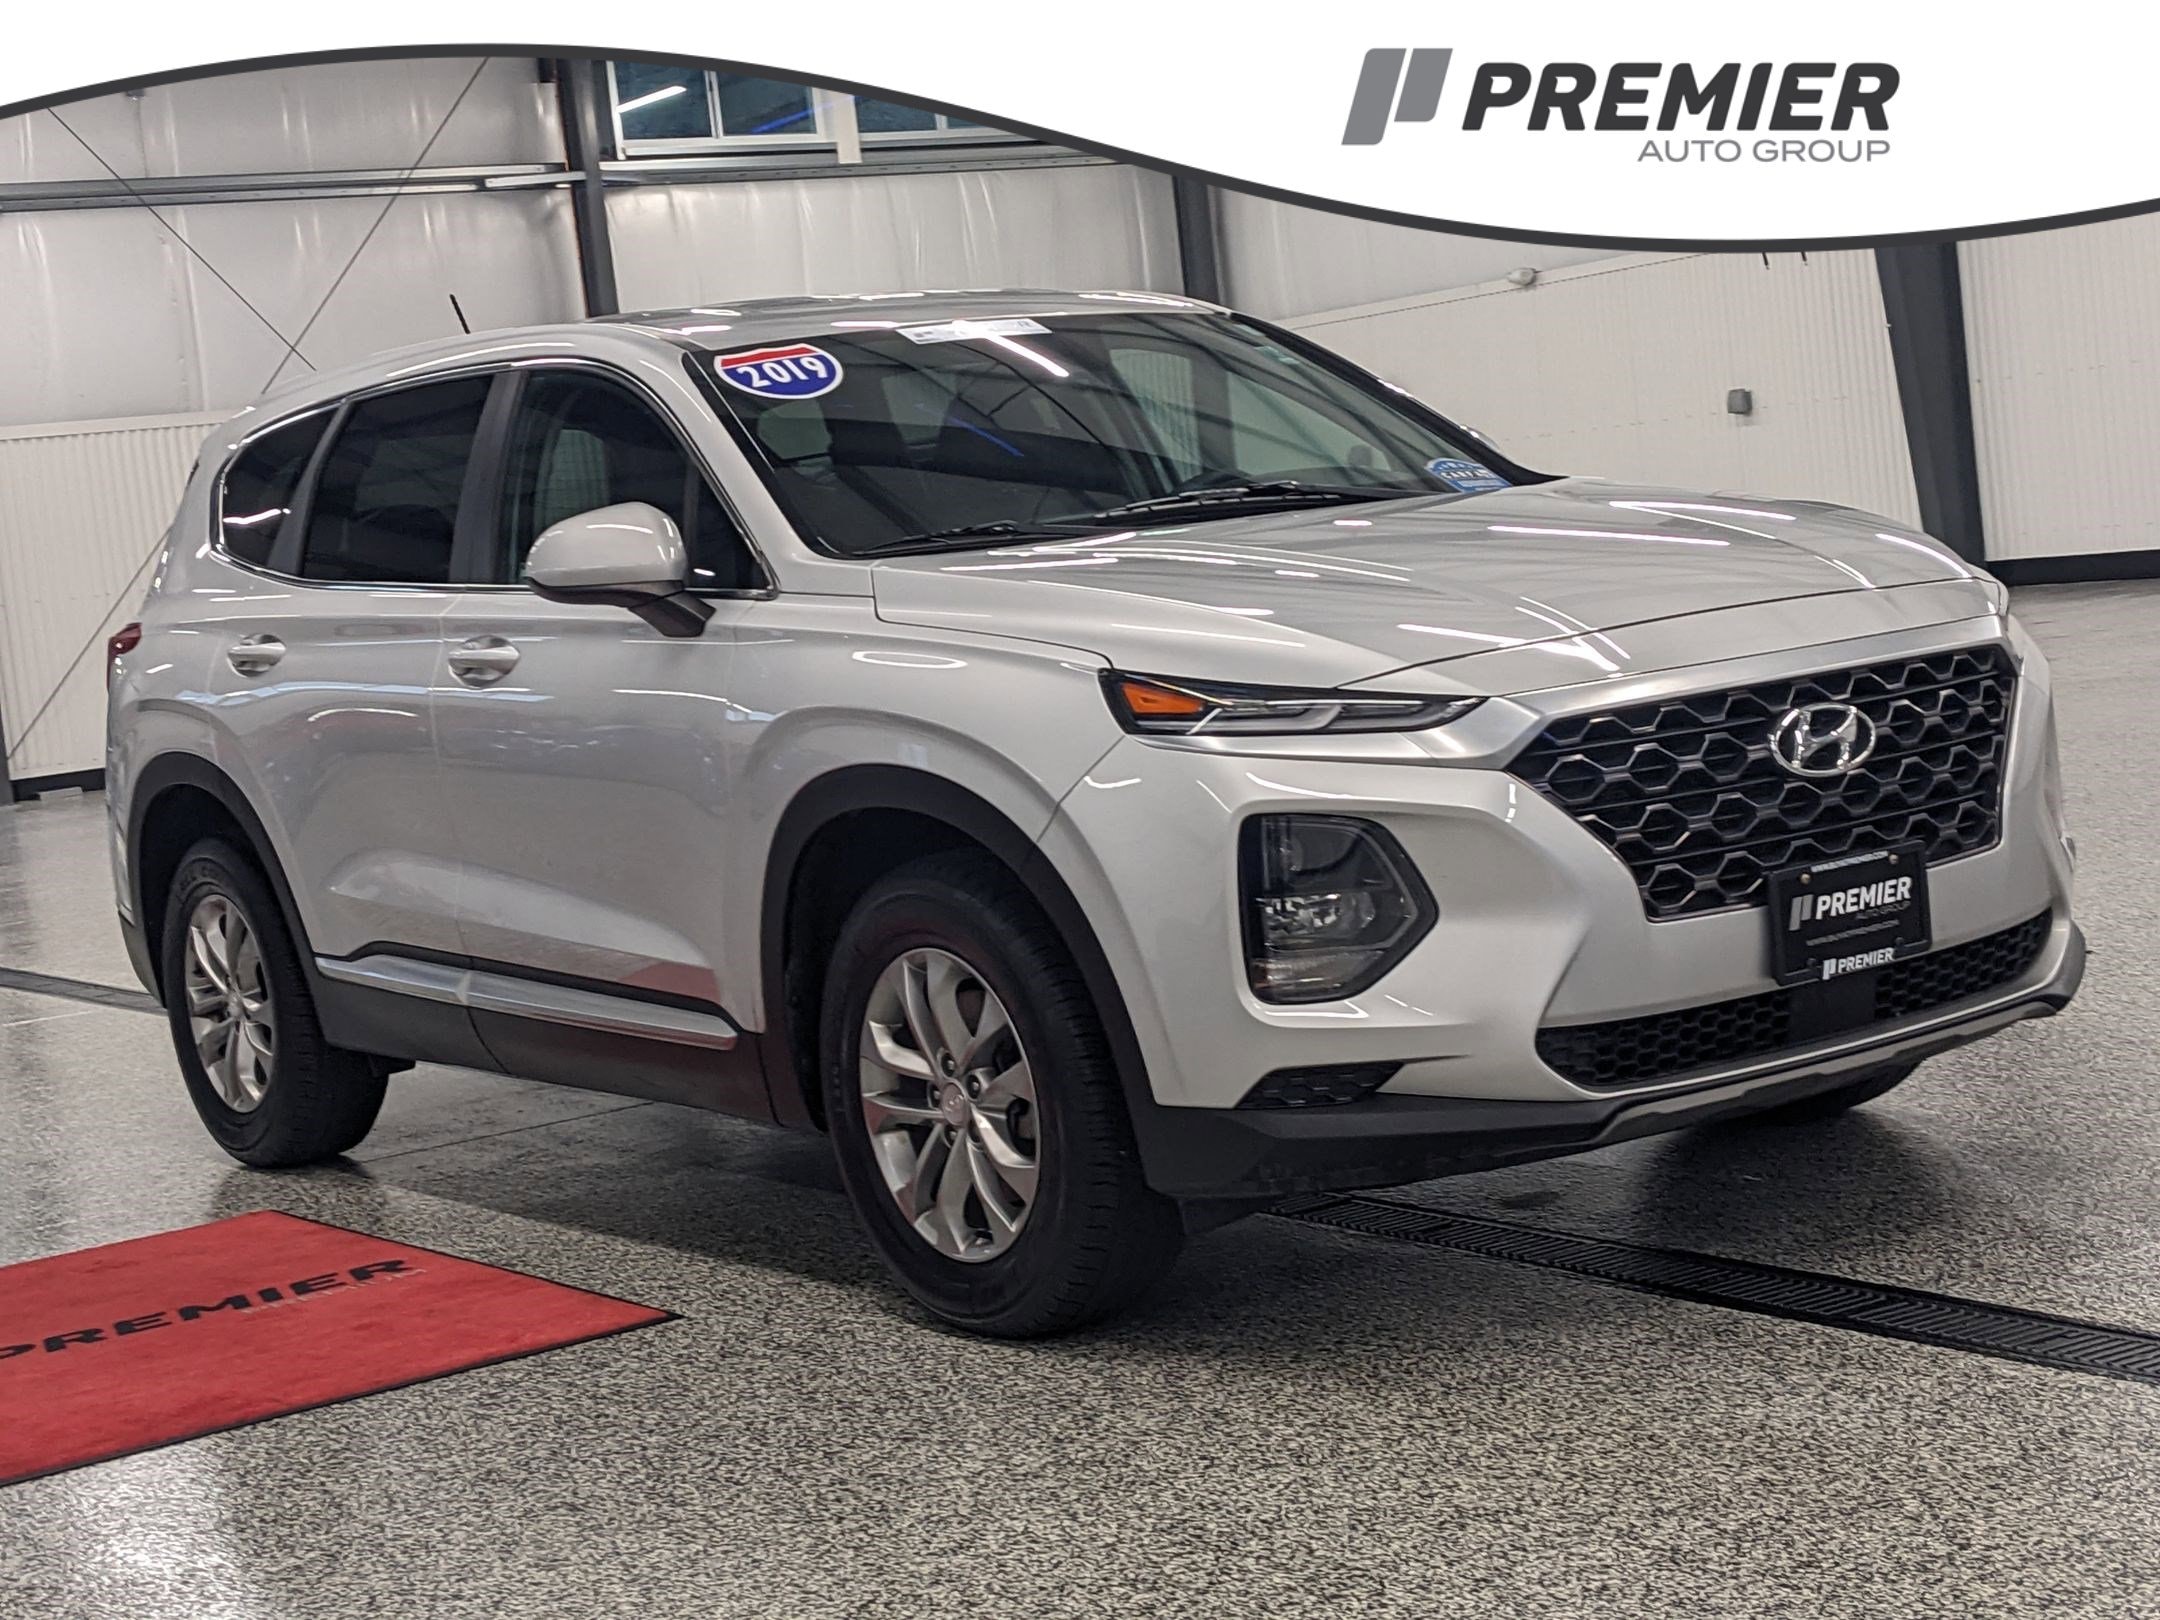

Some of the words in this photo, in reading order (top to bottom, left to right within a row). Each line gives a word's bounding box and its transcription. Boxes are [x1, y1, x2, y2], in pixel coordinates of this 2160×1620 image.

[736, 357, 828, 388] 2019
[1815, 877, 1912, 919] PREMIER
[1838, 947, 1895, 973] PREMIER
